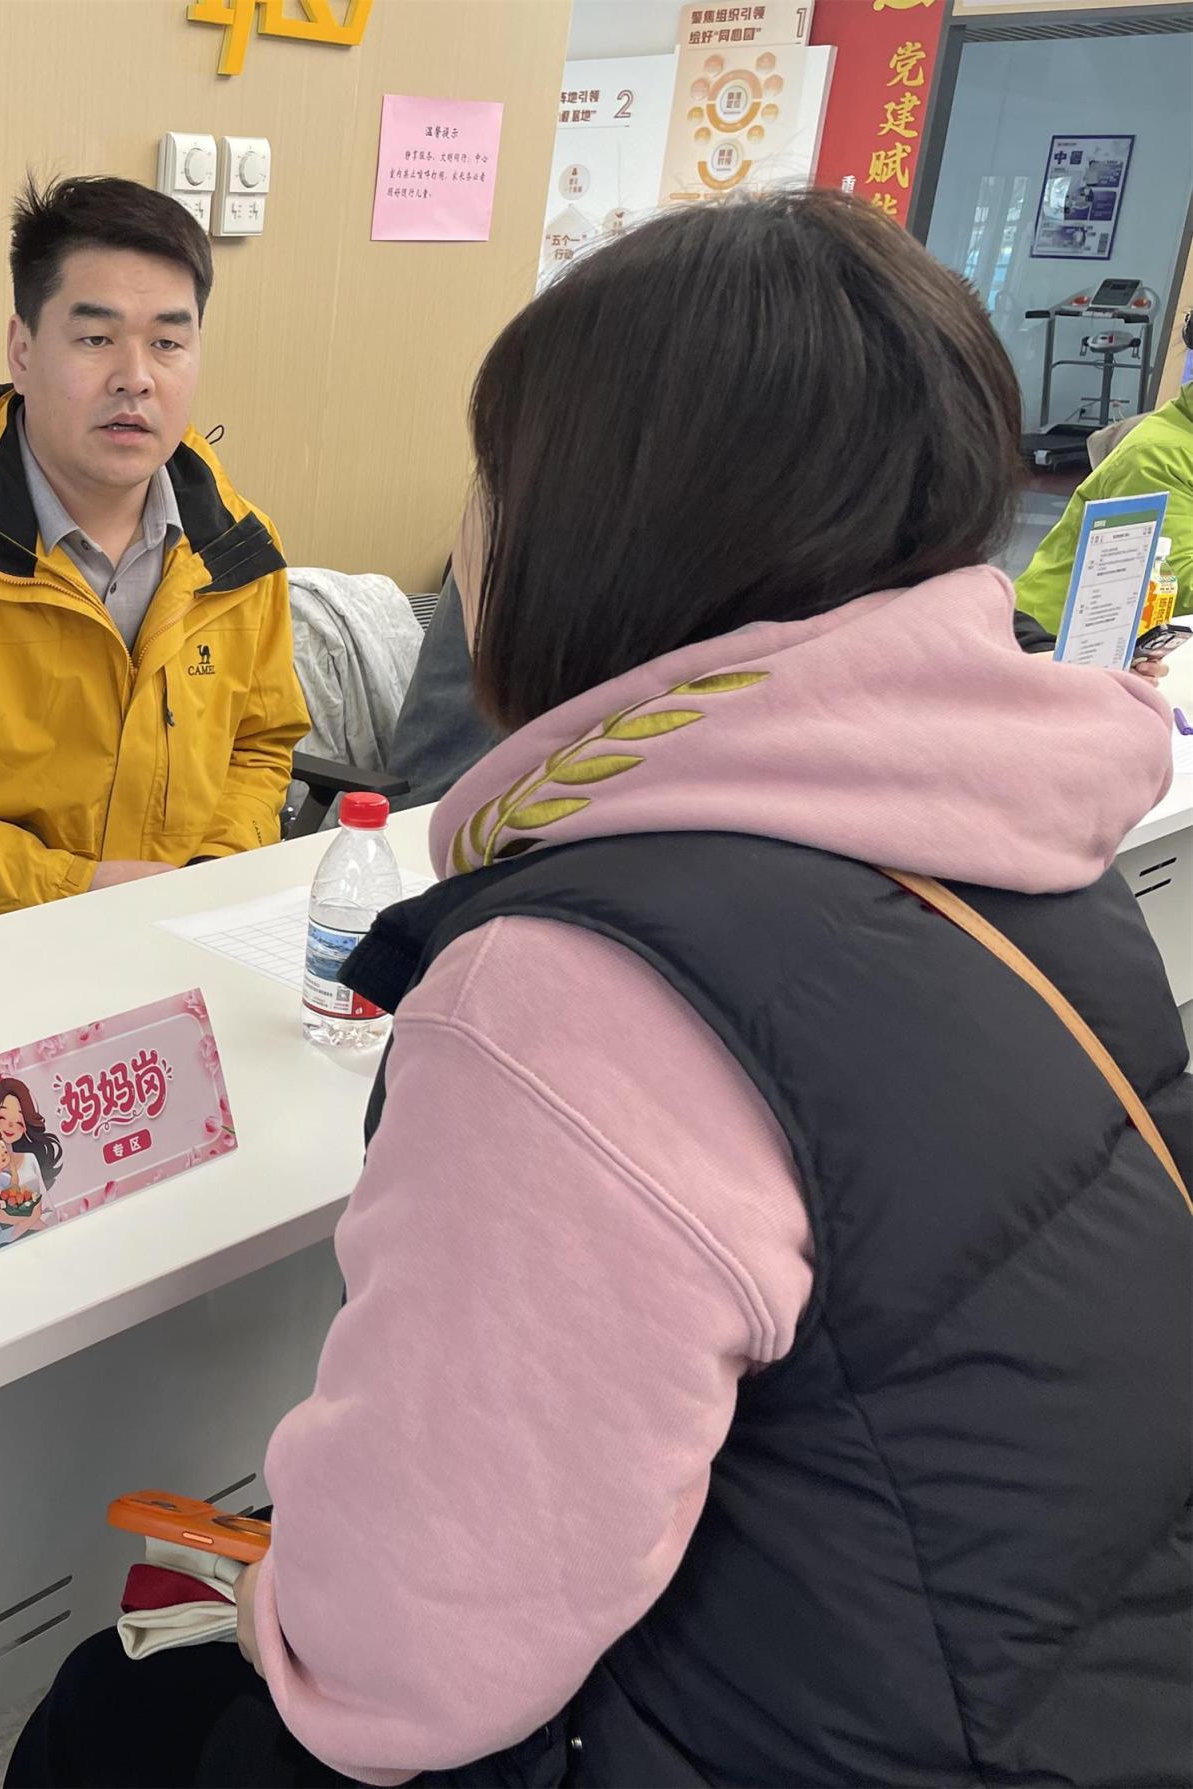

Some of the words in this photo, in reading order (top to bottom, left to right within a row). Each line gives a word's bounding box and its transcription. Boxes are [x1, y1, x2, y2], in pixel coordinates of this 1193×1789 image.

[691, 6, 766, 24] 聚焦组织引领
[613, 89, 634, 119] 2
[425, 126, 459, 139] 温馨提示
[187, 665, 216, 676] CAMEL
[59, 1049, 167, 1134] 妈妈岗
[112, 1137, 142, 1158] 专区
